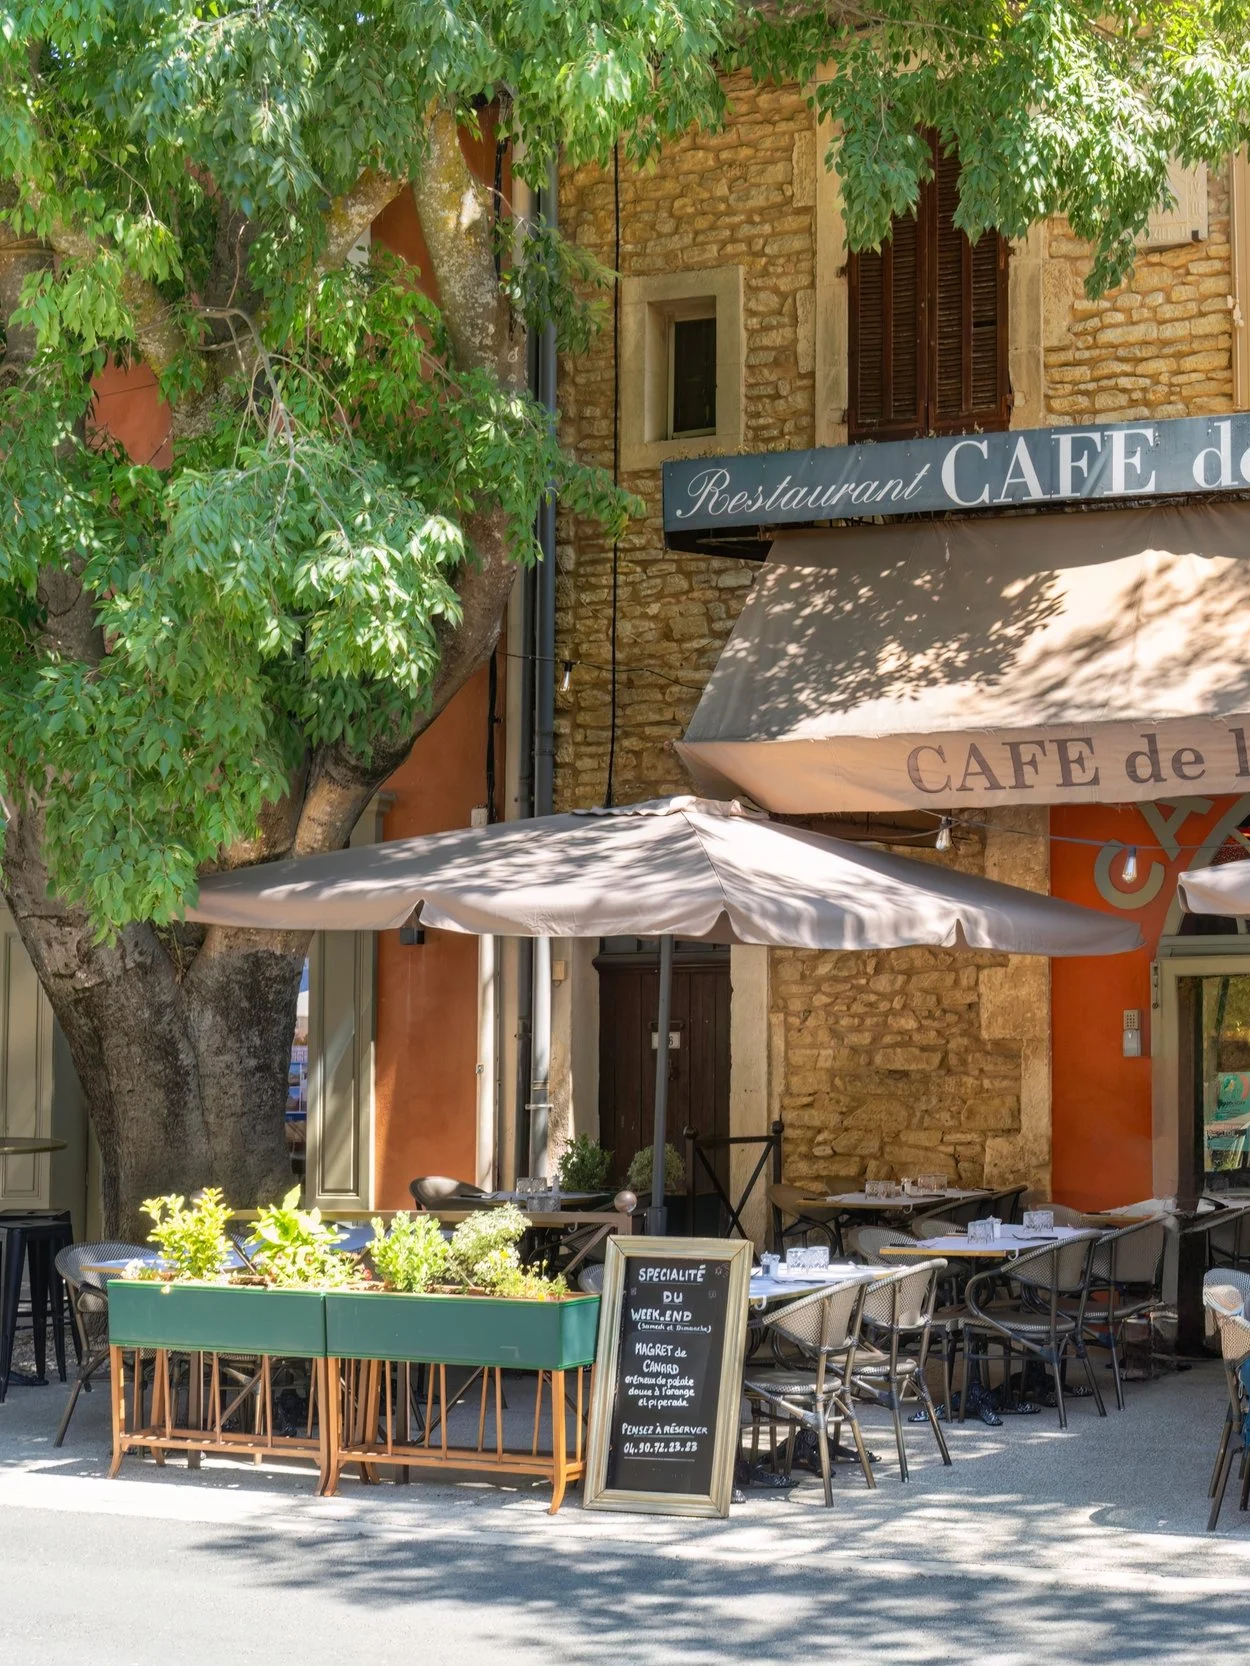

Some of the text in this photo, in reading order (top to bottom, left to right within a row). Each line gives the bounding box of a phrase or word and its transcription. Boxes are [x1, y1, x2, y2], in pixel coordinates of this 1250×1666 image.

[675, 461, 930, 520] Restaurant
[940, 428, 1157, 506] CAFE
[906, 737, 1101, 793] CAFE
[1125, 732, 1206, 785] de
[638, 1264, 707, 1282] SPECIALITÉ
[663, 1291, 683, 1303] DU
[635, 1342, 687, 1358] MAGRET de
[642, 1359, 680, 1375] CANARD
[656, 1376, 666, 1384] de
[667, 1375, 695, 1388] patate
[628, 1386, 696, 1399] douce à l'orange
[638, 1398, 689, 1410] et piperade
[622, 1422, 709, 1436] PENSEZ À RÉSERVER
[624, 1441, 699, 1456] 04.90.72.23.23
